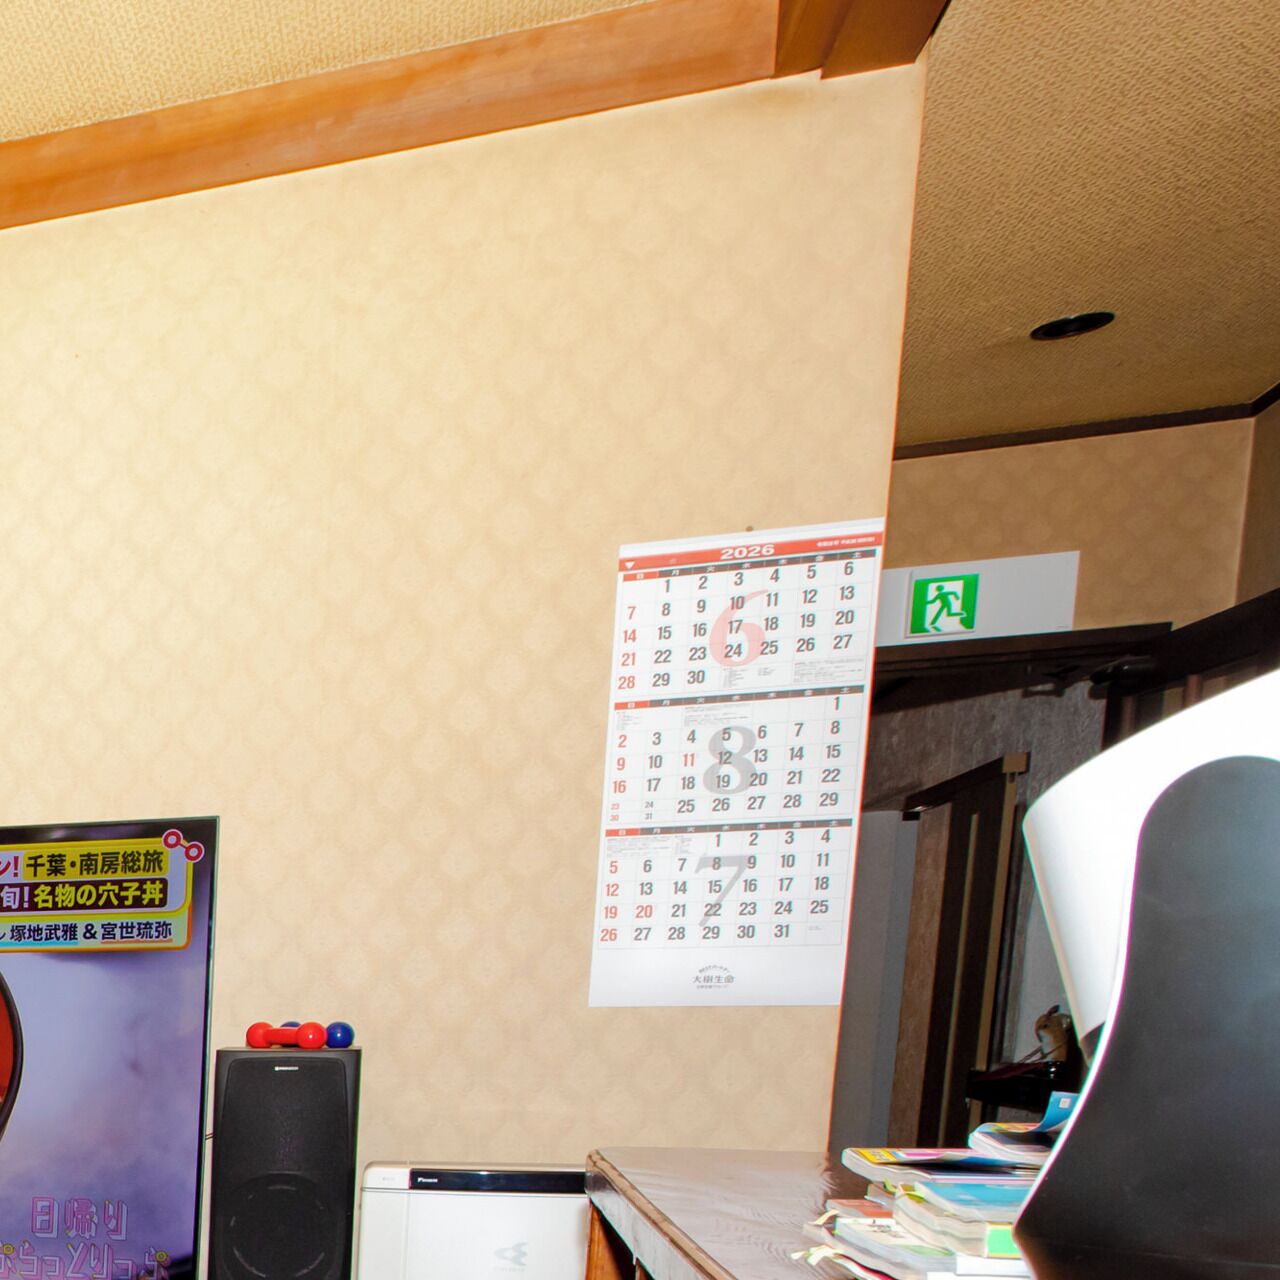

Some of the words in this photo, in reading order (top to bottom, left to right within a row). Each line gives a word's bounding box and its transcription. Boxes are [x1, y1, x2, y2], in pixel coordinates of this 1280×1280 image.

[720, 543, 775, 561] 2026
[664, 578, 672, 593] 1
[697, 575, 708, 590] 2
[733, 572, 744, 587] 3
[769, 568, 780, 583] 4
[806, 565, 817, 580] 5
[843, 561, 854, 576] 6
[627, 605, 637, 620] 7
[661, 602, 672, 617] 8
[696, 599, 707, 614] 9
[730, 595, 746, 611] 10
[766, 592, 779, 608] 11
[802, 588, 819, 605] 12
[839, 585, 856, 601] 13
[623, 628, 637, 644] 14
[657, 625, 673, 641] 15
[693, 622, 708, 638] 16
[727, 618, 744, 635] 17
[764, 616, 781, 632] 18
[800, 612, 817, 629] 19
[834, 609, 856, 626] 20
[709, 589, 769, 667] 6
[620, 652, 636, 667] 21
[653, 648, 673, 664] 22
[688, 646, 707, 662] 23
[723, 643, 743, 659] 24
[759, 639, 779, 656] 25
[796, 637, 816, 653] 26
[832, 633, 853, 650] 27
[617, 675, 636, 690] 28
[652, 672, 671, 688] 29
[687, 669, 707, 685] 30
[833, 696, 841, 711] 1
[617, 734, 628, 749] 2
[652, 731, 662, 746] 3
[686, 729, 697, 744] 4
[721, 726, 733, 742] 5
[757, 724, 768, 740] 6
[794, 722, 805, 737] 7
[830, 720, 841, 735] 8
[616, 756, 626, 772] 9
[648, 754, 664, 769] 10
[683, 752, 695, 767] 11
[717, 750, 733, 765] 12
[753, 748, 769, 763] 13
[789, 745, 805, 761] 14
[826, 743, 841, 759] 15
[702, 726, 758, 795] 8
[613, 779, 627, 794] 16
[647, 777, 662, 793] 17
[681, 775, 696, 791] 18
[715, 774, 731, 789] 19
[748, 772, 769, 787] 20
[786, 769, 803, 785] 21
[821, 767, 841, 783] 22
[677, 798, 696, 814] 25
[711, 797, 731, 812] 26
[746, 795, 767, 810] 27
[782, 793, 803, 809] 28
[819, 791, 840, 807] 29
[714, 833, 722, 848] 1
[748, 832, 759, 846] 2
[784, 830, 795, 845] 3
[820, 828, 831, 844] 4
[26, 849, 165, 877] 千葉・南房総旅
[609, 860, 619, 874] 5
[643, 859, 653, 873] 6
[677, 857, 688, 872] 7
[711, 856, 723, 871] 8
[747, 855, 758, 870] 9
[780, 853, 797, 869] 10
[816, 852, 831, 867] 11
[605, 883, 620, 897] 12
[639, 881, 654, 896] 13
[673, 880, 688, 895] 14
[708, 879, 723, 894] 15
[743, 878, 758, 893] 16
[778, 876, 795, 892] 17
[814, 876, 831, 891] 18
[694, 854, 751, 928] 7
[604, 905, 618, 920] 19
[635, 904, 653, 919] 20
[671, 903, 687, 918] 21
[703, 901, 723, 918] 22
[738, 901, 758, 916] 23
[774, 900, 793, 915] 24
[809, 899, 829, 914] 25
[10, 923, 78, 942] 塚地武雅
[83, 926, 97, 940] &
[101, 920, 173, 941] 宮世琉弥
[599, 928, 618, 942] 26
[633, 927, 652, 941] 27
[667, 926, 686, 941] 28
[702, 925, 721, 940] 29
[736, 924, 757, 939] 30
[773, 923, 791, 938] 31
[31, 1197, 129, 1242] 日帰り
